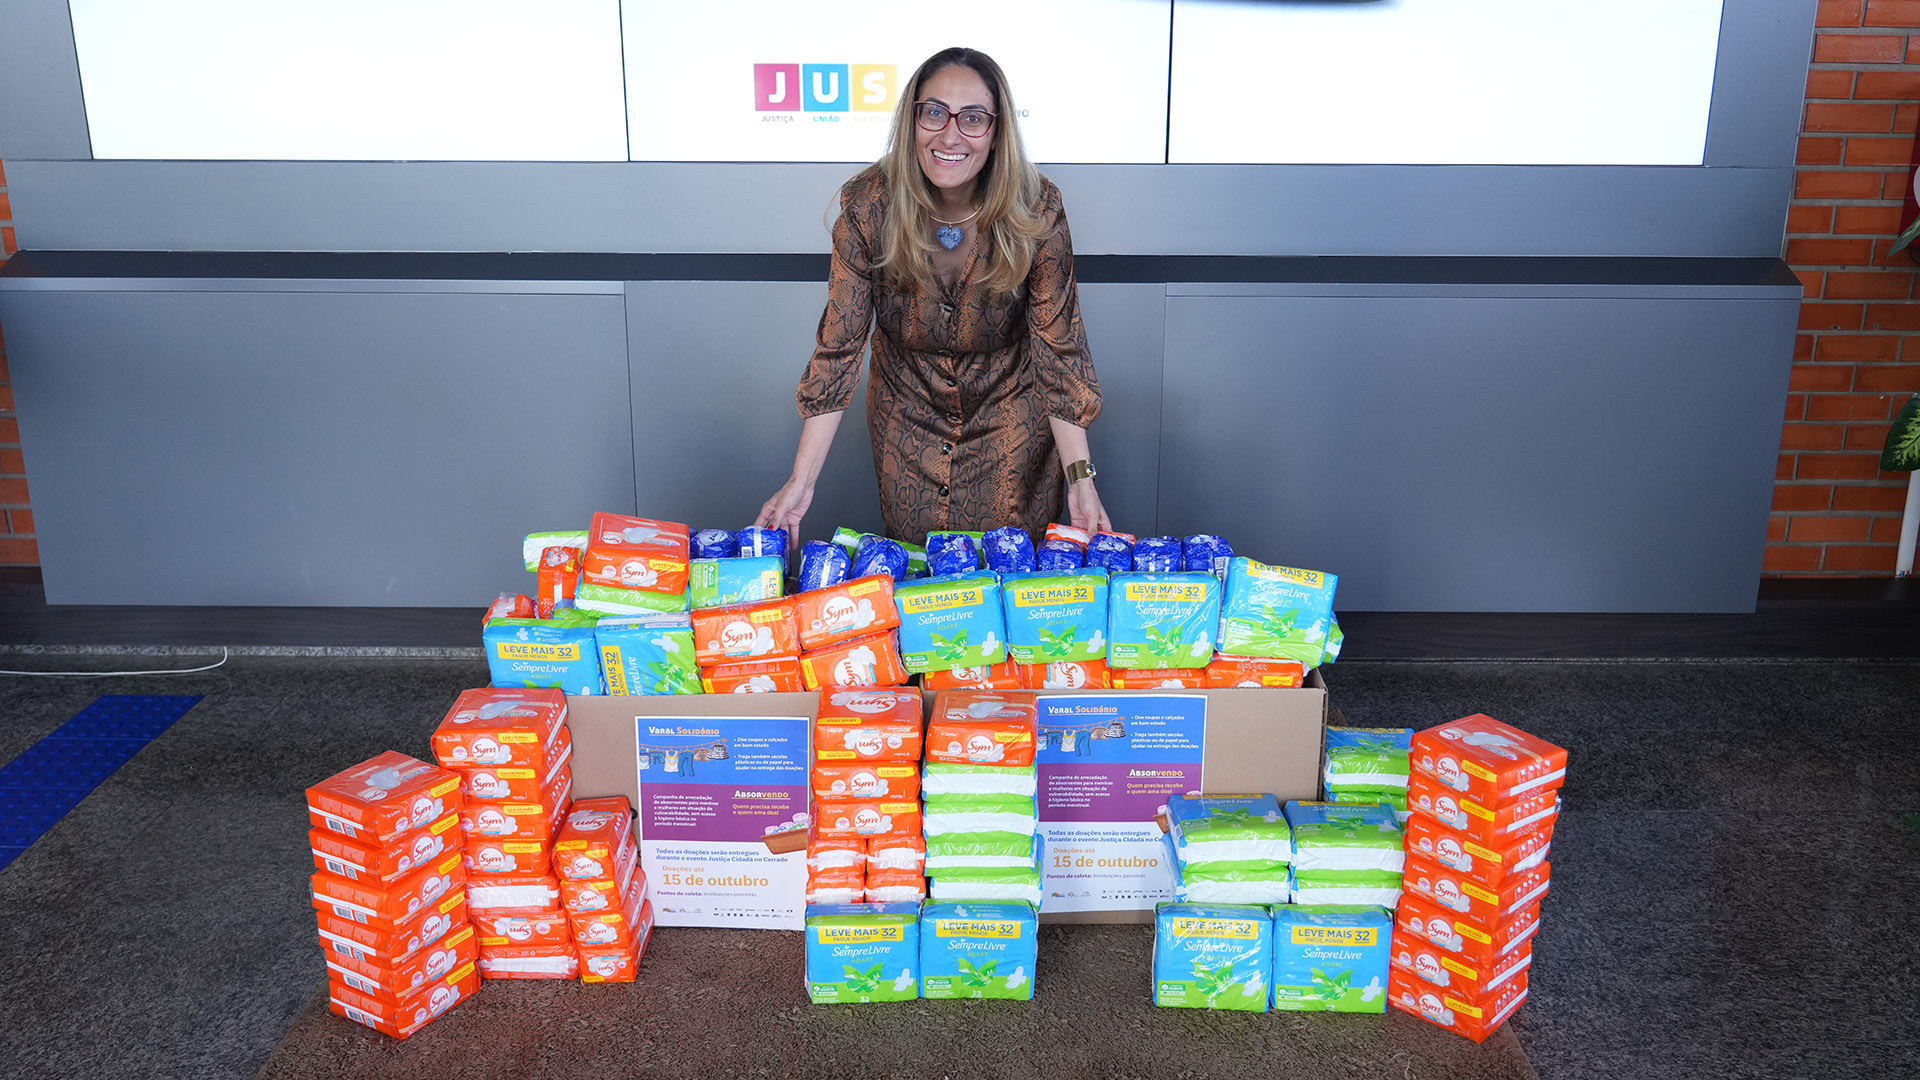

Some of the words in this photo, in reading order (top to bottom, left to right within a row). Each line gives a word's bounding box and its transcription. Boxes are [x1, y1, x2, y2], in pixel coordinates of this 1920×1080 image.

[761, 116, 794, 124] JUSTIÇA
[813, 115, 840, 123] UNIÃO
[622, 566, 645, 578] Sym
[1254, 562, 1278, 573] LEVE
[1279, 567, 1302, 578] MAIS
[1303, 571, 1319, 583] 32
[1021, 591, 1045, 600] LEVE
[1048, 588, 1072, 598] MAIS
[1073, 588, 1088, 598] 32
[1133, 585, 1157, 593] LEVE
[1159, 585, 1184, 594] MAIS
[1184, 586, 1200, 597] 32
[909, 595, 934, 606] LEVE
[936, 592, 960, 602] MAIS
[961, 590, 976, 602] 32
[826, 606, 854, 625] Sym
[918, 611, 974, 626] SempreLivre
[1027, 607, 1083, 620] SempreLivre
[723, 629, 753, 647] Sym
[531, 647, 556, 655] MAIS
[557, 648, 573, 657] 32
[512, 662, 569, 673] SempreLivre
[473, 743, 498, 758] Sym
[968, 741, 991, 755] Sym
[1437, 761, 1458, 777] Sym
[472, 778, 495, 791] Sym
[852, 778, 875, 791] Sym
[1435, 800, 1456, 815] Sym
[479, 816, 502, 828] Sym
[856, 816, 879, 828] Sym
[1120, 830, 1151, 838] entregues
[685, 848, 710, 856] doações
[729, 849, 760, 857] entregues
[1053, 847, 1083, 855] Doações
[1437, 843, 1460, 858] Sym
[480, 853, 502, 866] Sym
[709, 855, 731, 863] Justiça
[1053, 855, 1071, 868] 15
[1075, 856, 1093, 868] de
[1098, 856, 1159, 868] outubro
[662, 865, 692, 873] Doações
[663, 873, 682, 886] 15
[685, 874, 704, 886] de
[707, 875, 769, 887] outubro
[1435, 884, 1457, 899] Sym
[825, 928, 851, 937] LEVE
[853, 928, 879, 936] MAIS
[880, 928, 897, 937] 32
[943, 922, 968, 931] LEVE
[971, 923, 996, 931] MAIS
[997, 923, 1014, 934] 32
[1180, 920, 1205, 930] LEVE
[1208, 921, 1233, 930] MAIS
[1235, 922, 1251, 934] 32
[1427, 923, 1450, 939] Sym
[1298, 928, 1324, 937] LEVE
[1327, 930, 1352, 939] MAIS
[1354, 930, 1370, 941] 32
[947, 938, 1008, 951] SempreLivre
[831, 945, 891, 958] SempreLivre
[1302, 947, 1362, 961] SempreLivre
[1416, 957, 1438, 973] Sym
[1420, 998, 1442, 1014] Sym
